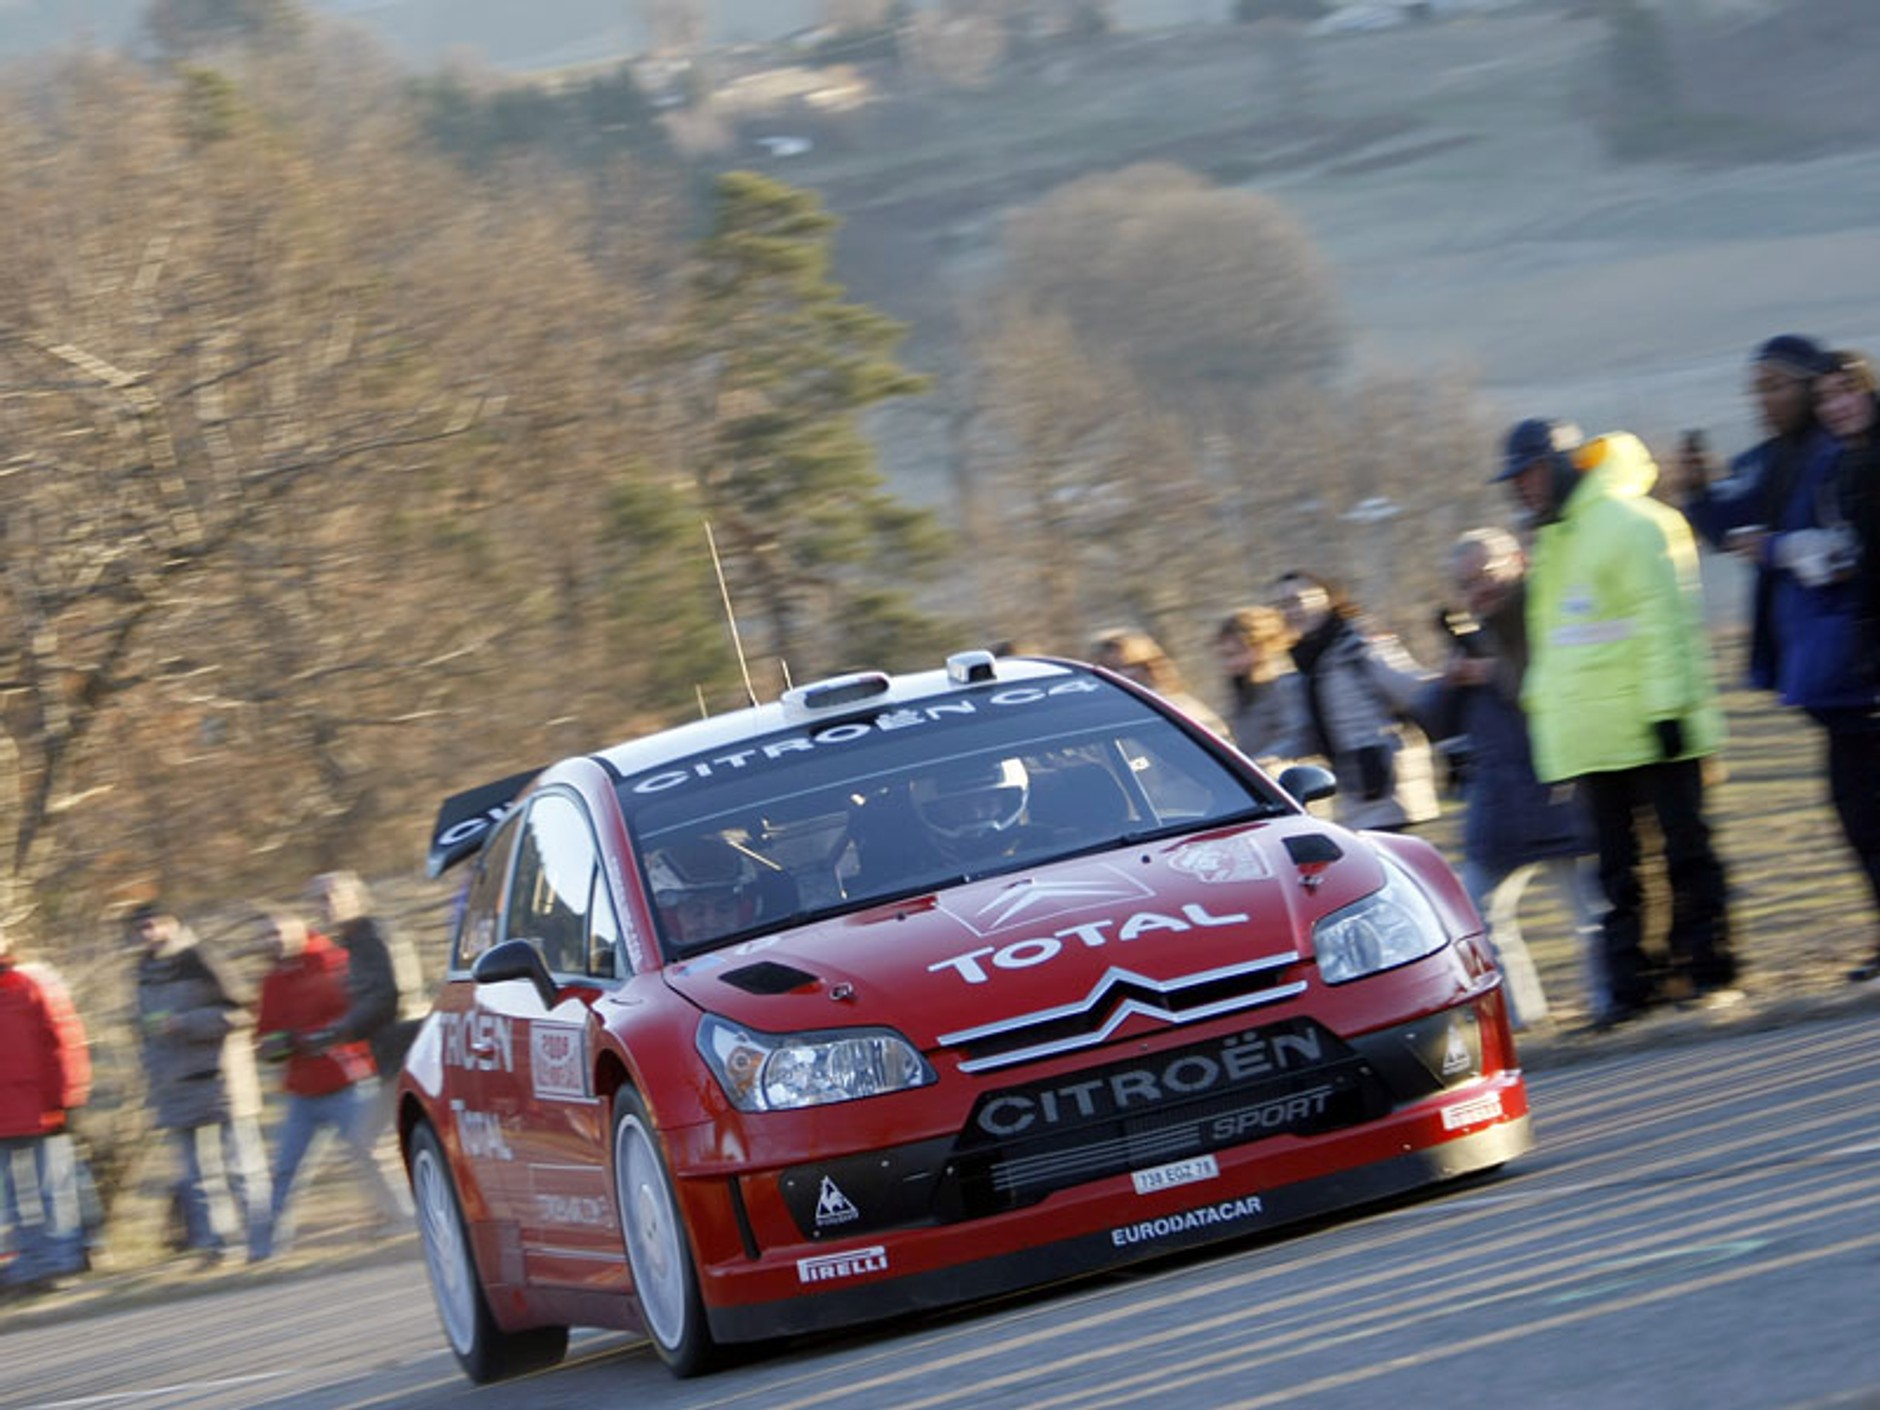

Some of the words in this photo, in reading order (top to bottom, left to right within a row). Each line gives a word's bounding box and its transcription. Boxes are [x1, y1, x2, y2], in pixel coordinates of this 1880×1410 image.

[633, 700, 977, 794] CITROËN
[989, 679, 1100, 704] C4
[927, 903, 1249, 984] TOTAL
[976, 1026, 1323, 1135] CITROËN
[1211, 1092, 1333, 1141] SPORT
[1111, 1196, 1263, 1246] EURODATACAR
[796, 1245, 889, 1283] PIRELLI
